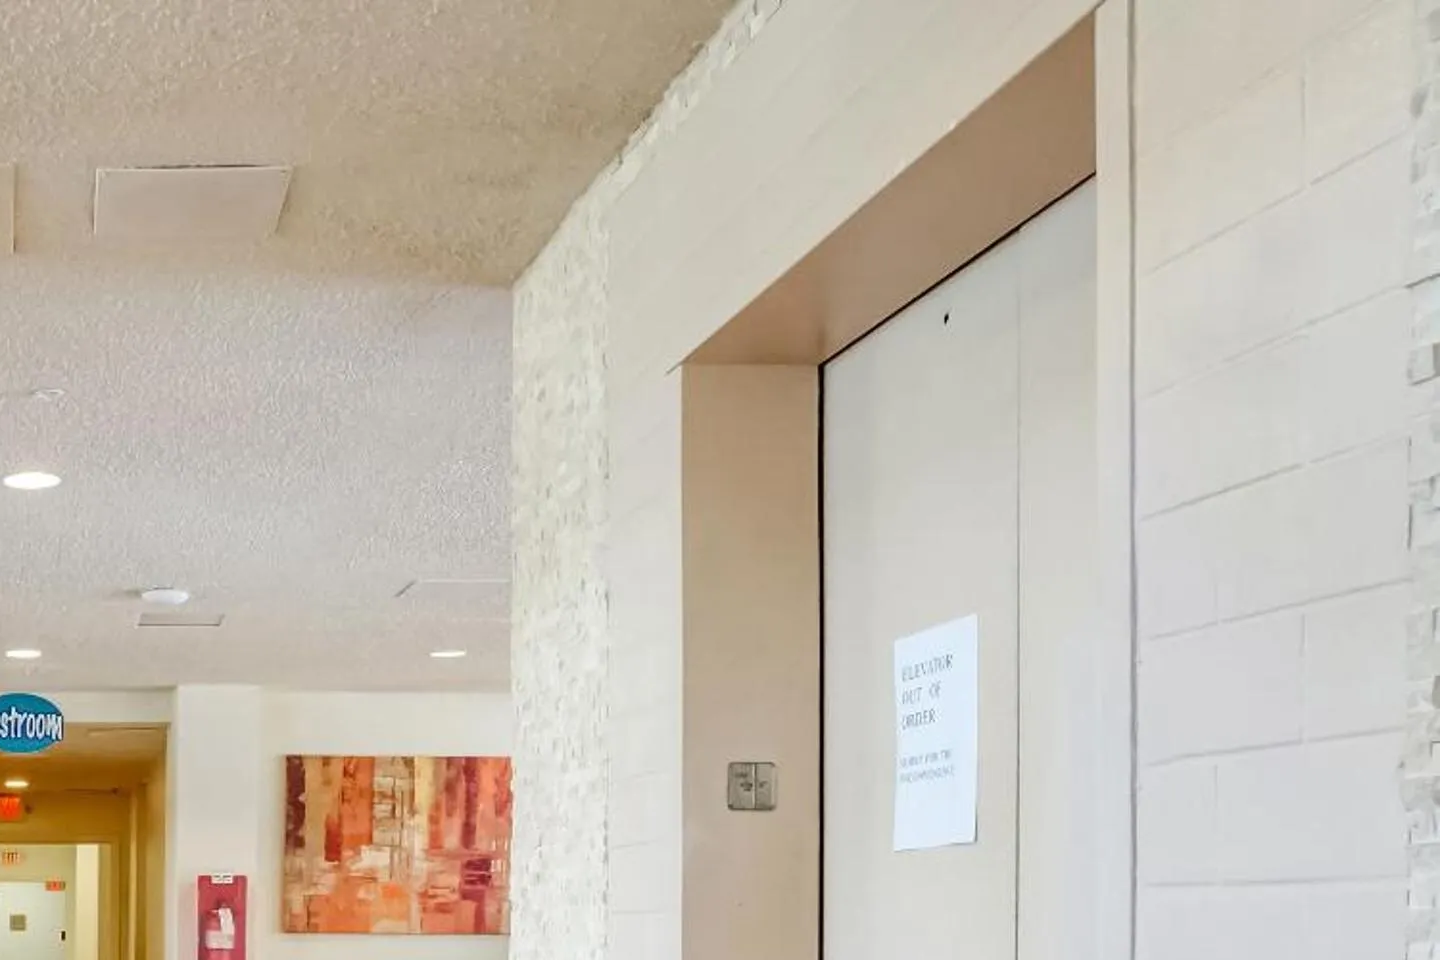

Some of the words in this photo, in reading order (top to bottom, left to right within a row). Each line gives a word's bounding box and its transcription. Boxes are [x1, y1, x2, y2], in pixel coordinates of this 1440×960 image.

[902, 654, 953, 682] ELEVATOR
[902, 686, 923, 704] OUT
[929, 680, 941, 699] OF
[902, 708, 936, 730] ORDER
